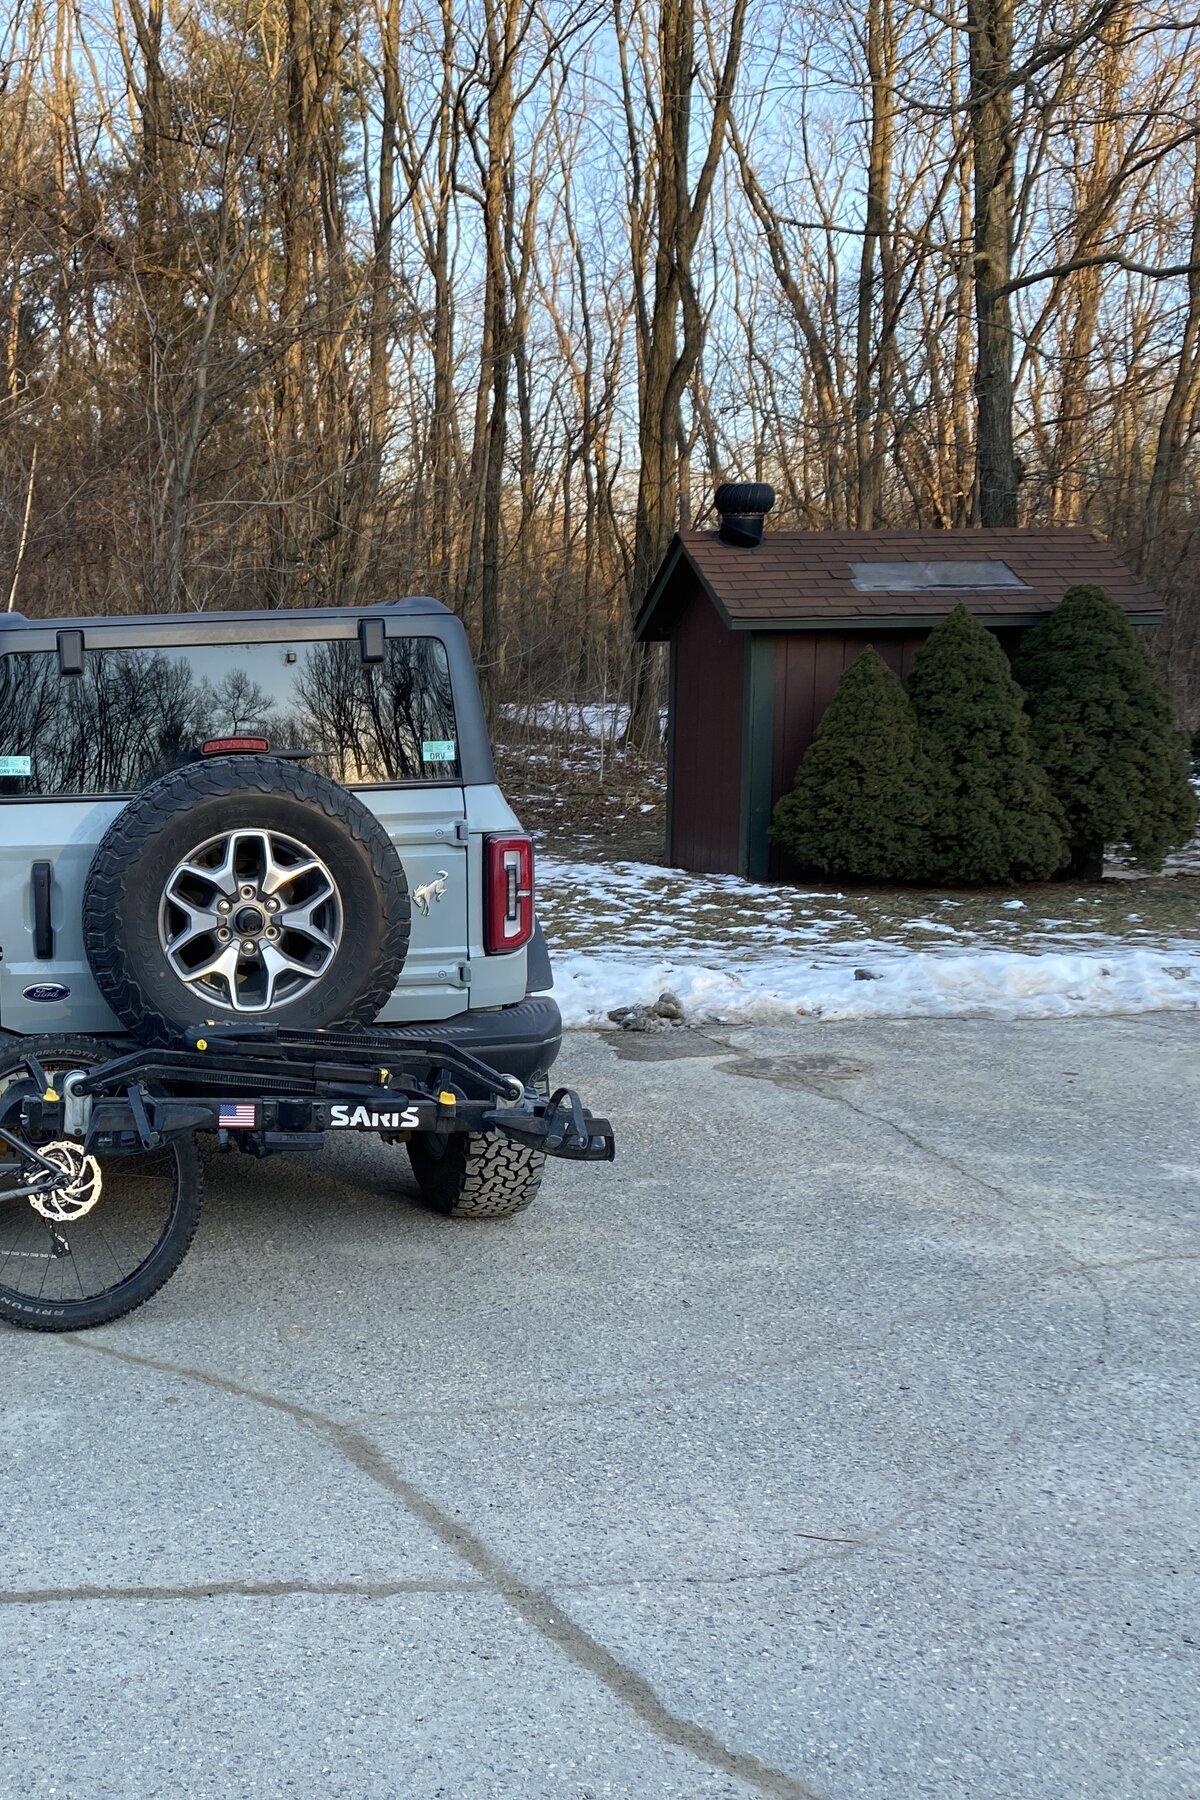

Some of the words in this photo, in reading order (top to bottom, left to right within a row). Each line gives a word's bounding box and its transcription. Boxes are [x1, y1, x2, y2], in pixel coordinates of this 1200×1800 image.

[429, 752, 445, 760] ORV
[330, 1105, 419, 1128] SARIS
[0, 1296, 65, 1316] ARISUN
